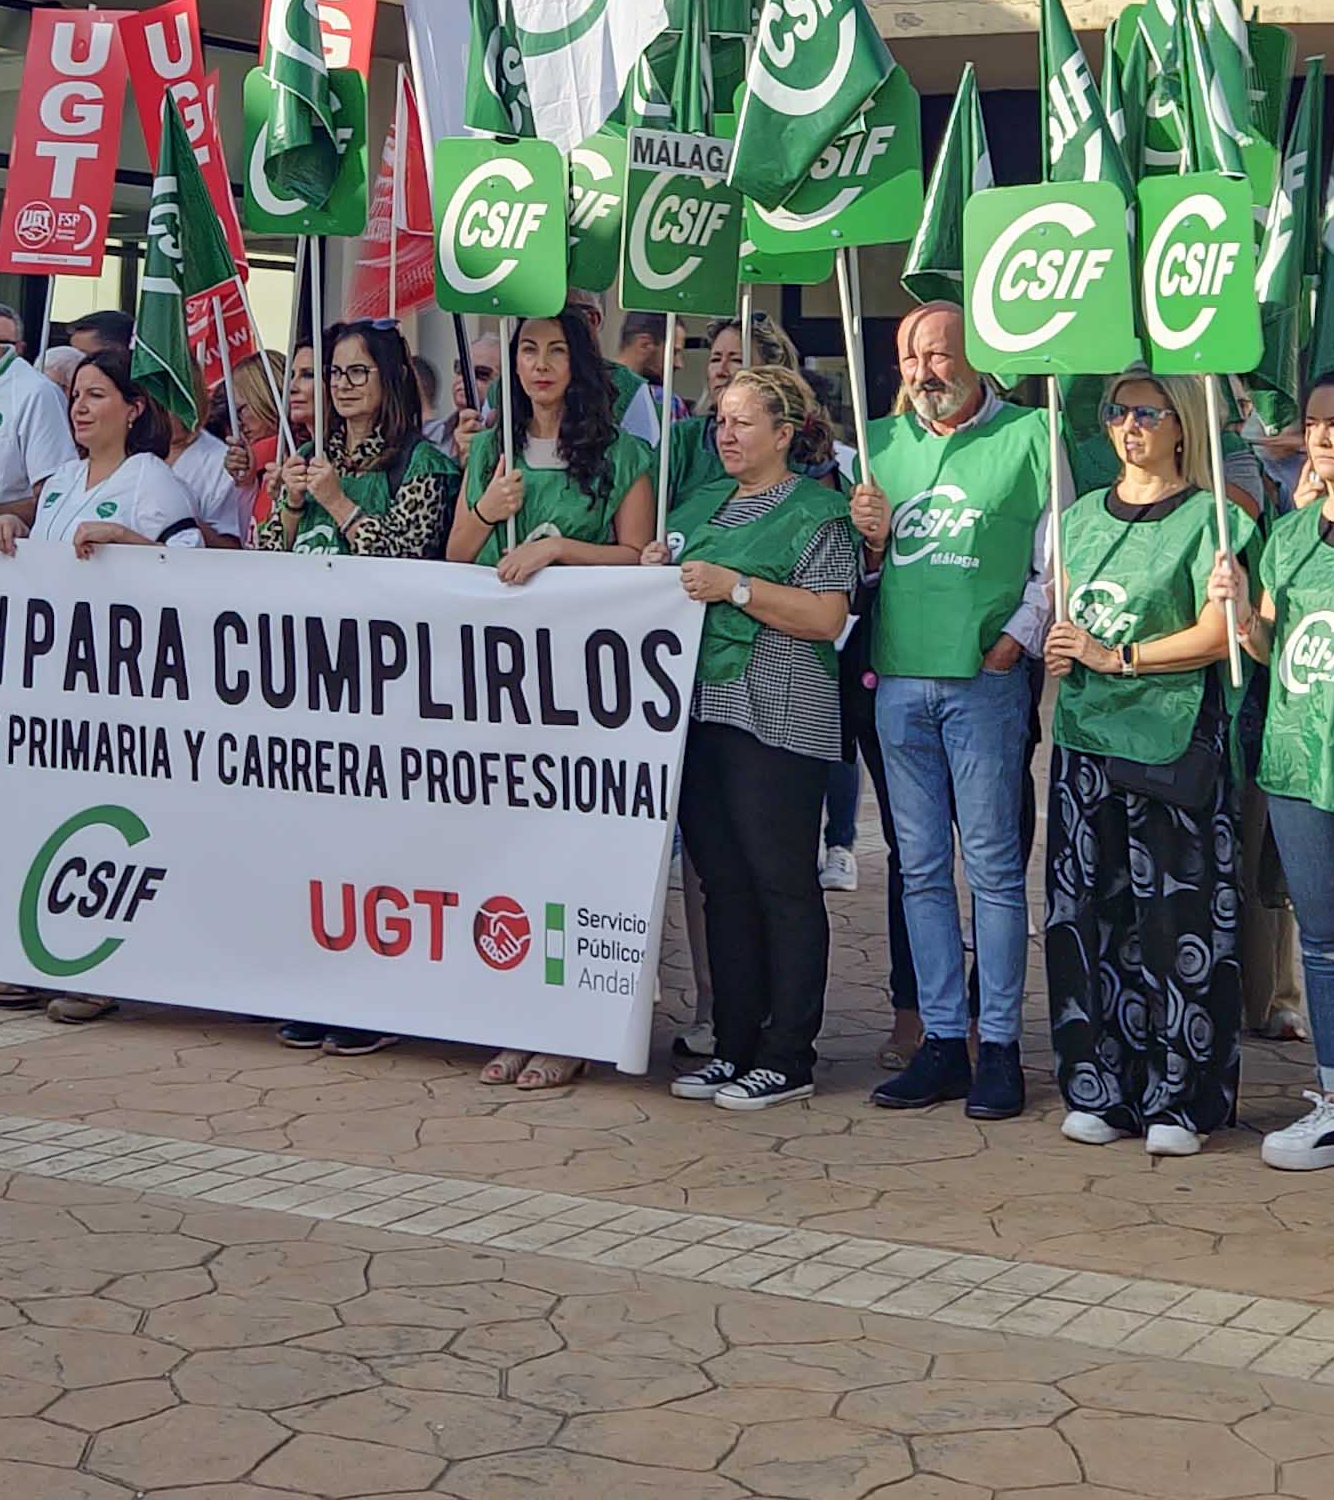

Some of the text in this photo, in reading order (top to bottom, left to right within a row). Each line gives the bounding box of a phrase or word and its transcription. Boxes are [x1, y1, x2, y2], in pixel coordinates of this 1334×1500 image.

[34, 21, 115, 200] UGT
[632, 129, 732, 174] MÁLAG
[810, 124, 897, 181] SIF
[458, 201, 548, 250] CSIF
[650, 194, 731, 247] CSIF
[999, 248, 1114, 302] CSIF
[1160, 241, 1241, 298] CSIF
[930, 552, 980, 568] Málaga
[24, 597, 189, 701] PARA
[213, 610, 684, 733] CUMPLIRLOS
[9, 715, 171, 780] PRIMARIA
[183, 730, 205, 782] Y
[217, 731, 388, 799] CARRERA
[400, 747, 668, 821] PROFESIONAL
[47, 855, 167, 923] CSIF
[309, 880, 459, 962] UGT
[577, 907, 649, 935] Servicio
[578, 967, 639, 997] Andal
